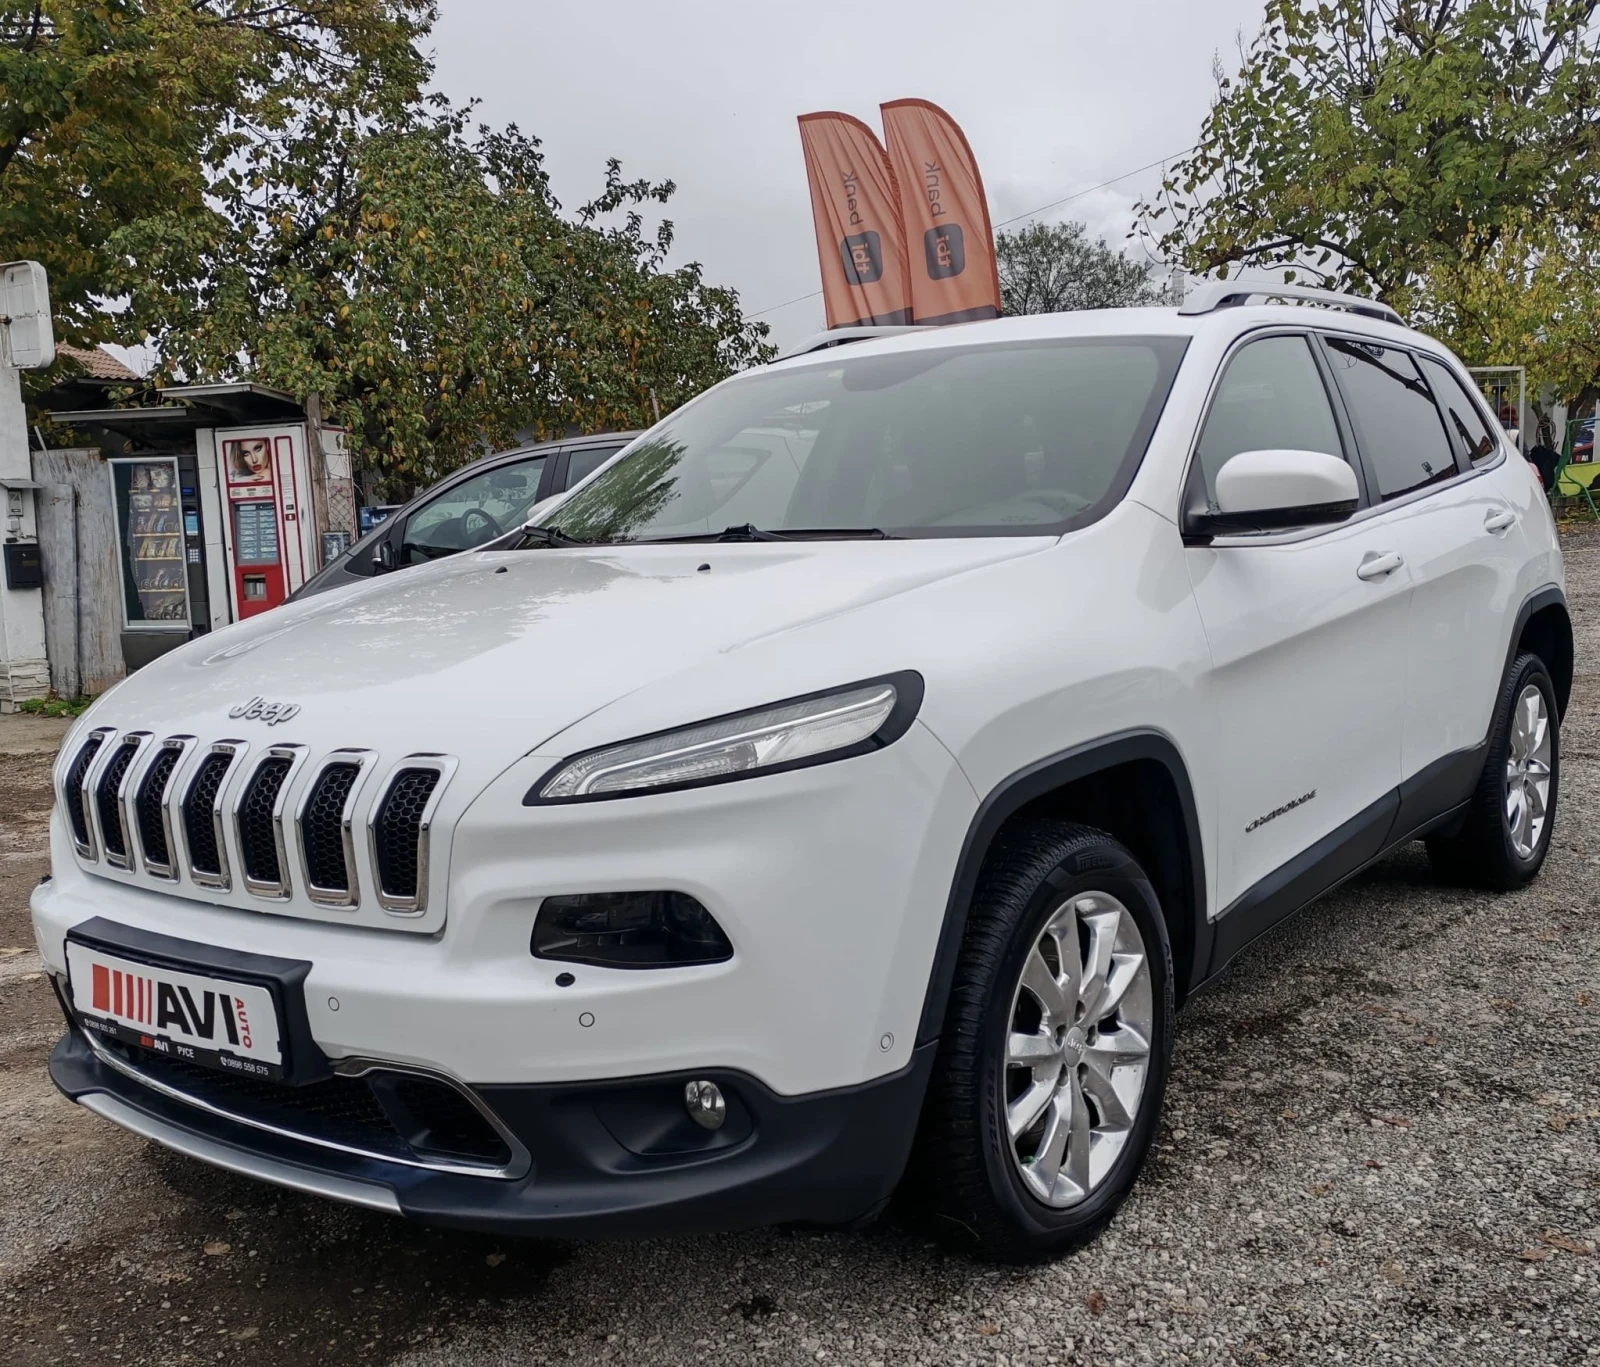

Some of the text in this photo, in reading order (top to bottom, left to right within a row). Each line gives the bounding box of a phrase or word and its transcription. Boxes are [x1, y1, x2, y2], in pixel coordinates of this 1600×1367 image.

[228, 696, 302, 727] Jeep
[157, 981, 240, 1046] AVI
[234, 997, 252, 1049] AUTO
[154, 1039, 170, 1052] AVI
[256, 1065, 269, 1076] 575
